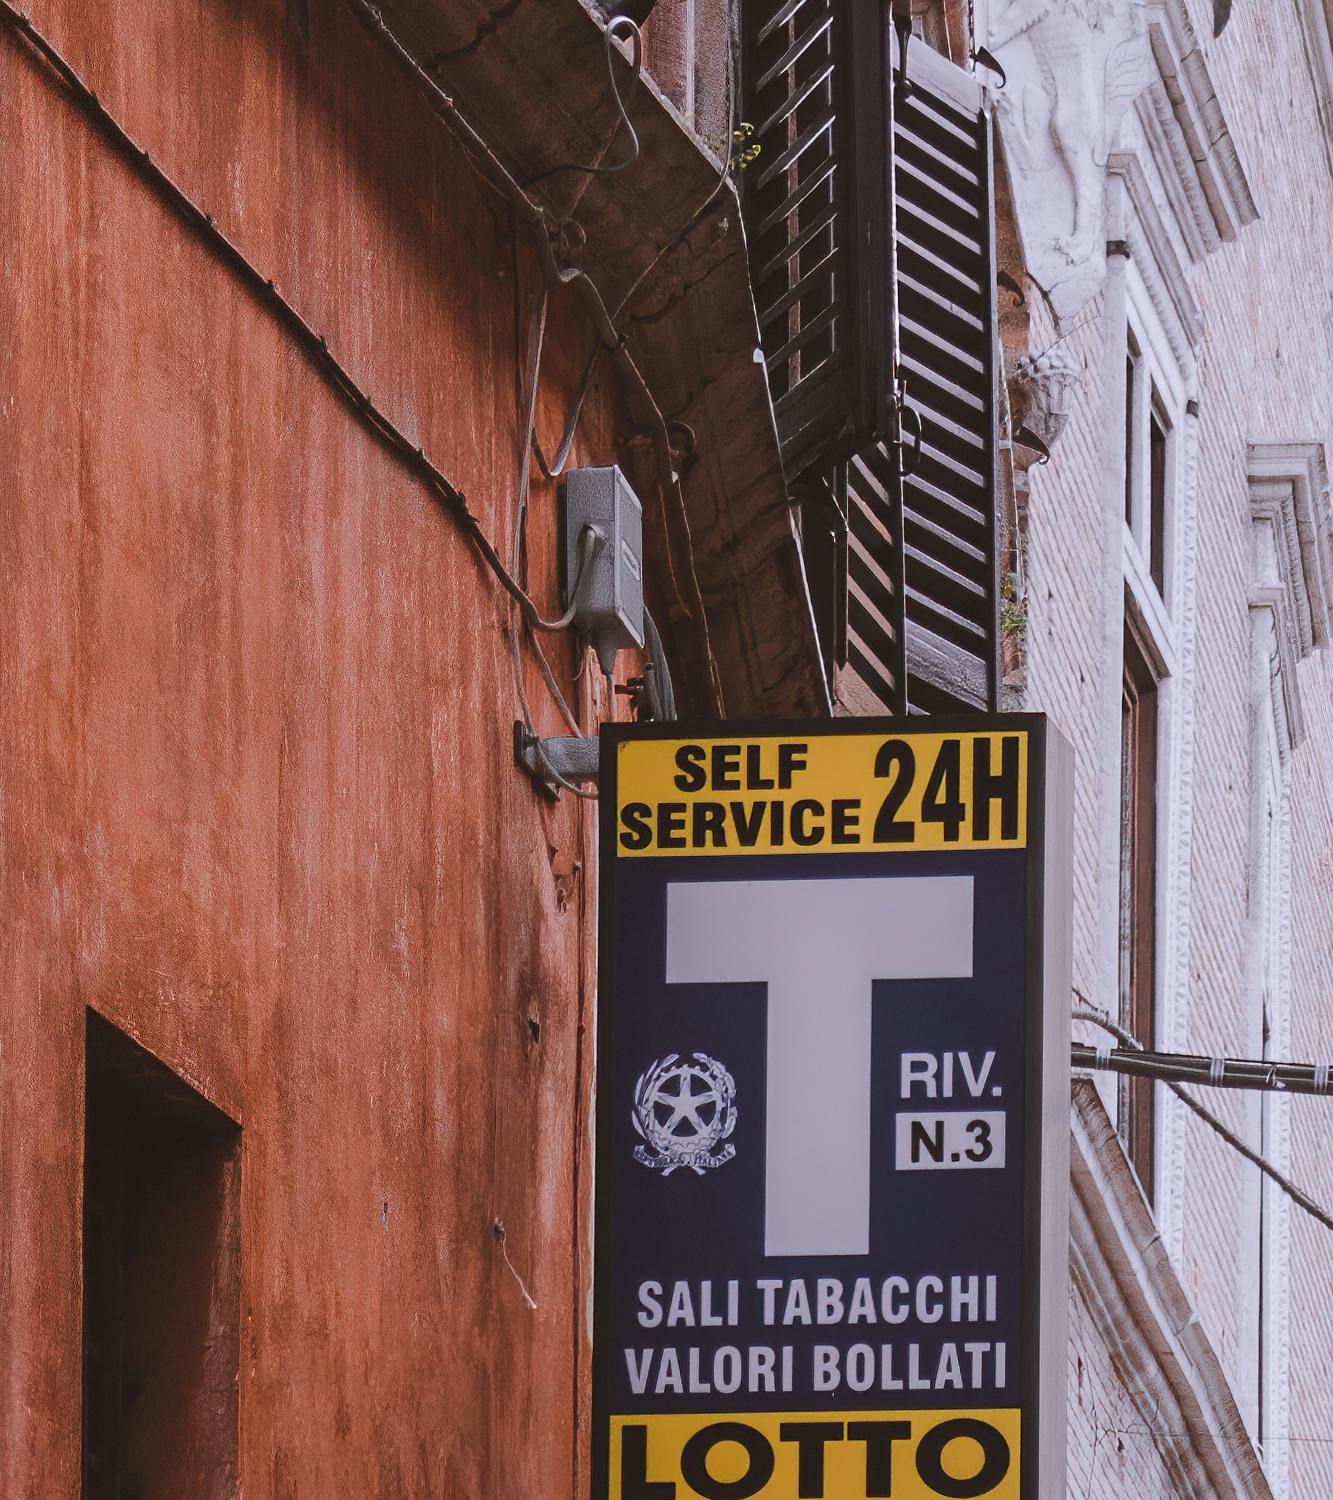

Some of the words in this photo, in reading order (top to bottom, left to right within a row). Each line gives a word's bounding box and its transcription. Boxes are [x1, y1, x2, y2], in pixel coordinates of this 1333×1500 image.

[674, 743, 808, 792] SELF
[873, 736, 1020, 843] 24H
[619, 799, 860, 851] SERVICE
[666, 875, 974, 1257] T
[900, 1050, 1002, 1099] RIV.
[910, 1119, 993, 1163] N.3
[637, 1280, 739, 1328] SALI
[757, 1275, 997, 1325] TABACCHI
[624, 1345, 793, 1394] VALORI
[813, 1342, 1006, 1392] BOLLATI
